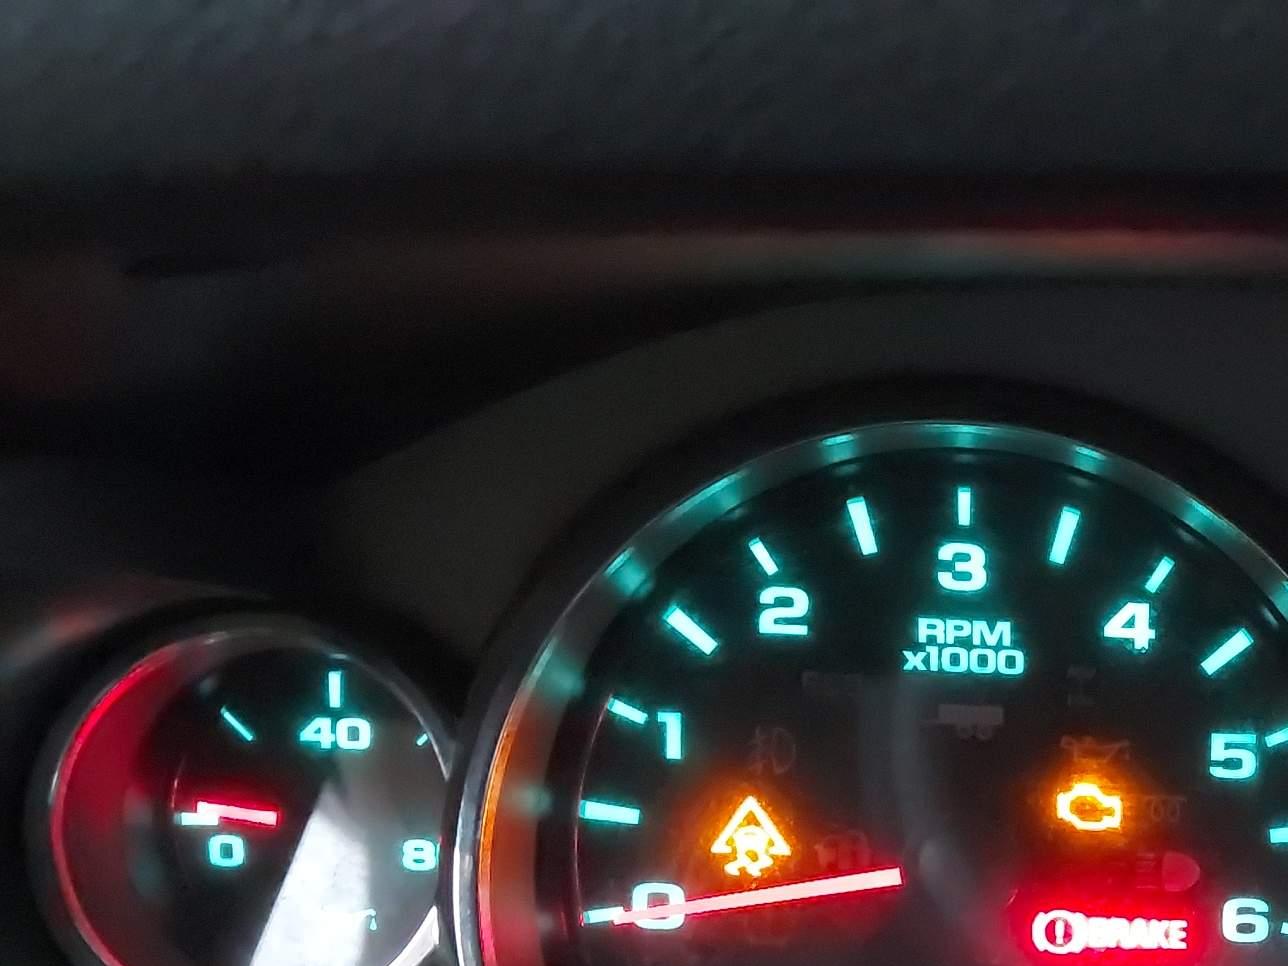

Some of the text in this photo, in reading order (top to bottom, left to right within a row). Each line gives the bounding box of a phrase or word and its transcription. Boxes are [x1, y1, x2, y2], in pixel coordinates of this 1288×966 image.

[937, 542, 987, 592] 3
[758, 586, 809, 636] 2
[917, 617, 1012, 646] RPM
[1103, 602, 1156, 652] 4
[902, 646, 1025, 675] x1000
[300, 718, 371, 750] 40
[657, 711, 683, 760] 1
[1209, 732, 1257, 779] 5
[208, 834, 245, 867] 0
[402, 838, 440, 871] 8
[631, 882, 686, 930] 0
[1221, 898, 1269, 943] 6
[1087, 916, 1188, 951] BRAKE
